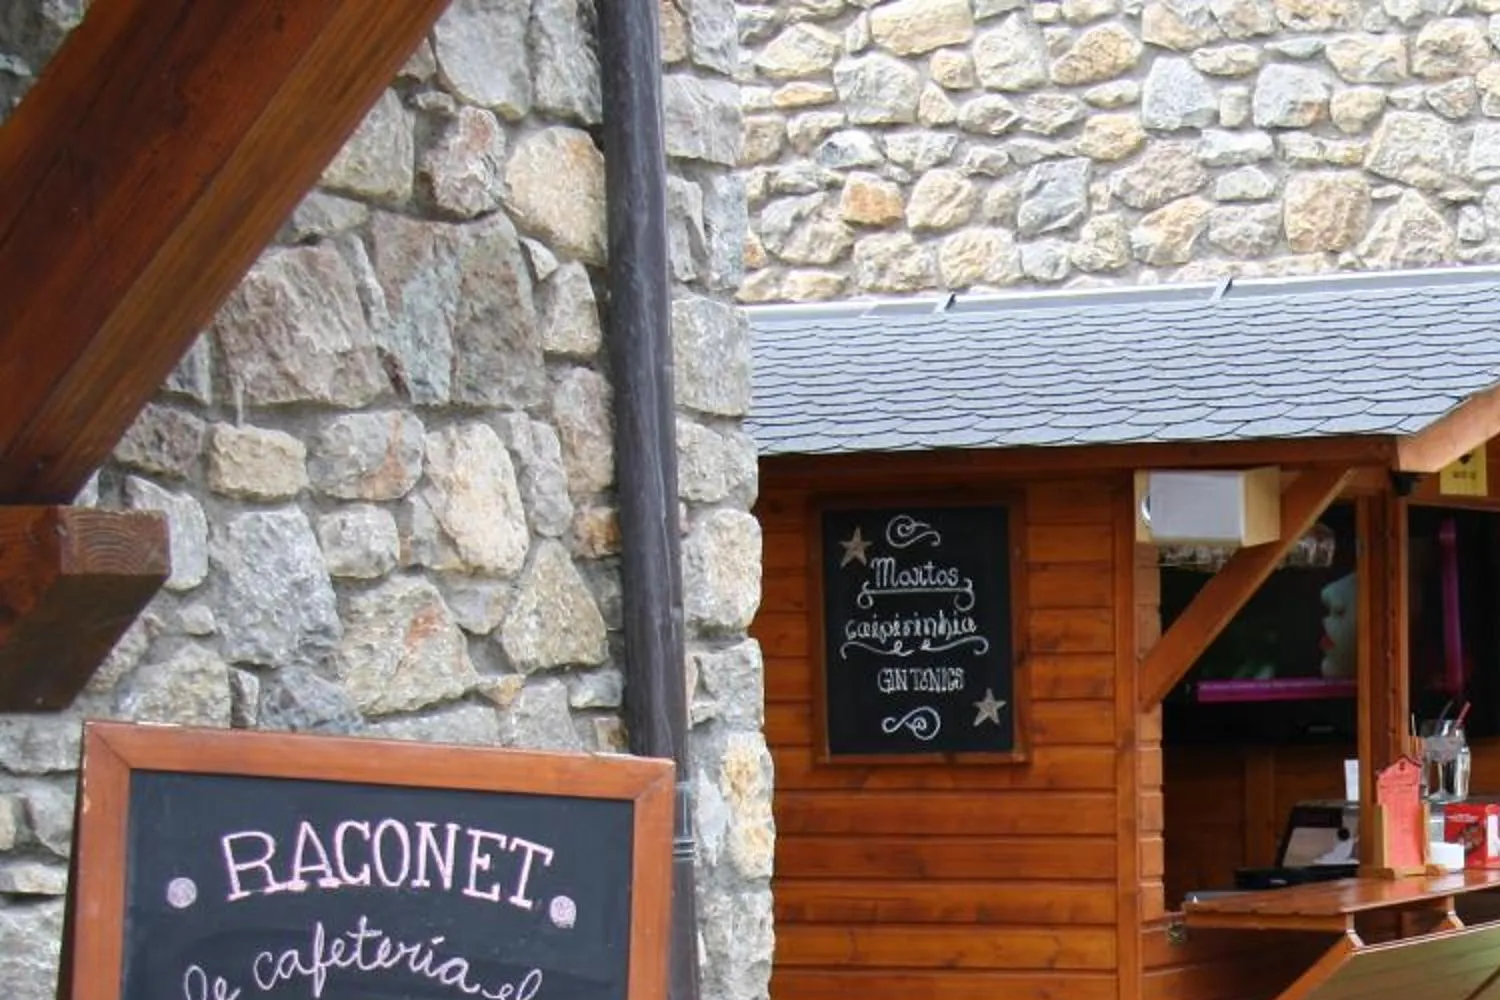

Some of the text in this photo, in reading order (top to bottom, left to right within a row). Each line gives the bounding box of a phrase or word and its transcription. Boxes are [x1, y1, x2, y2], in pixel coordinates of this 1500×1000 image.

[877, 667, 965, 694] GIN TONICS
[221, 818, 554, 909] RACONET
